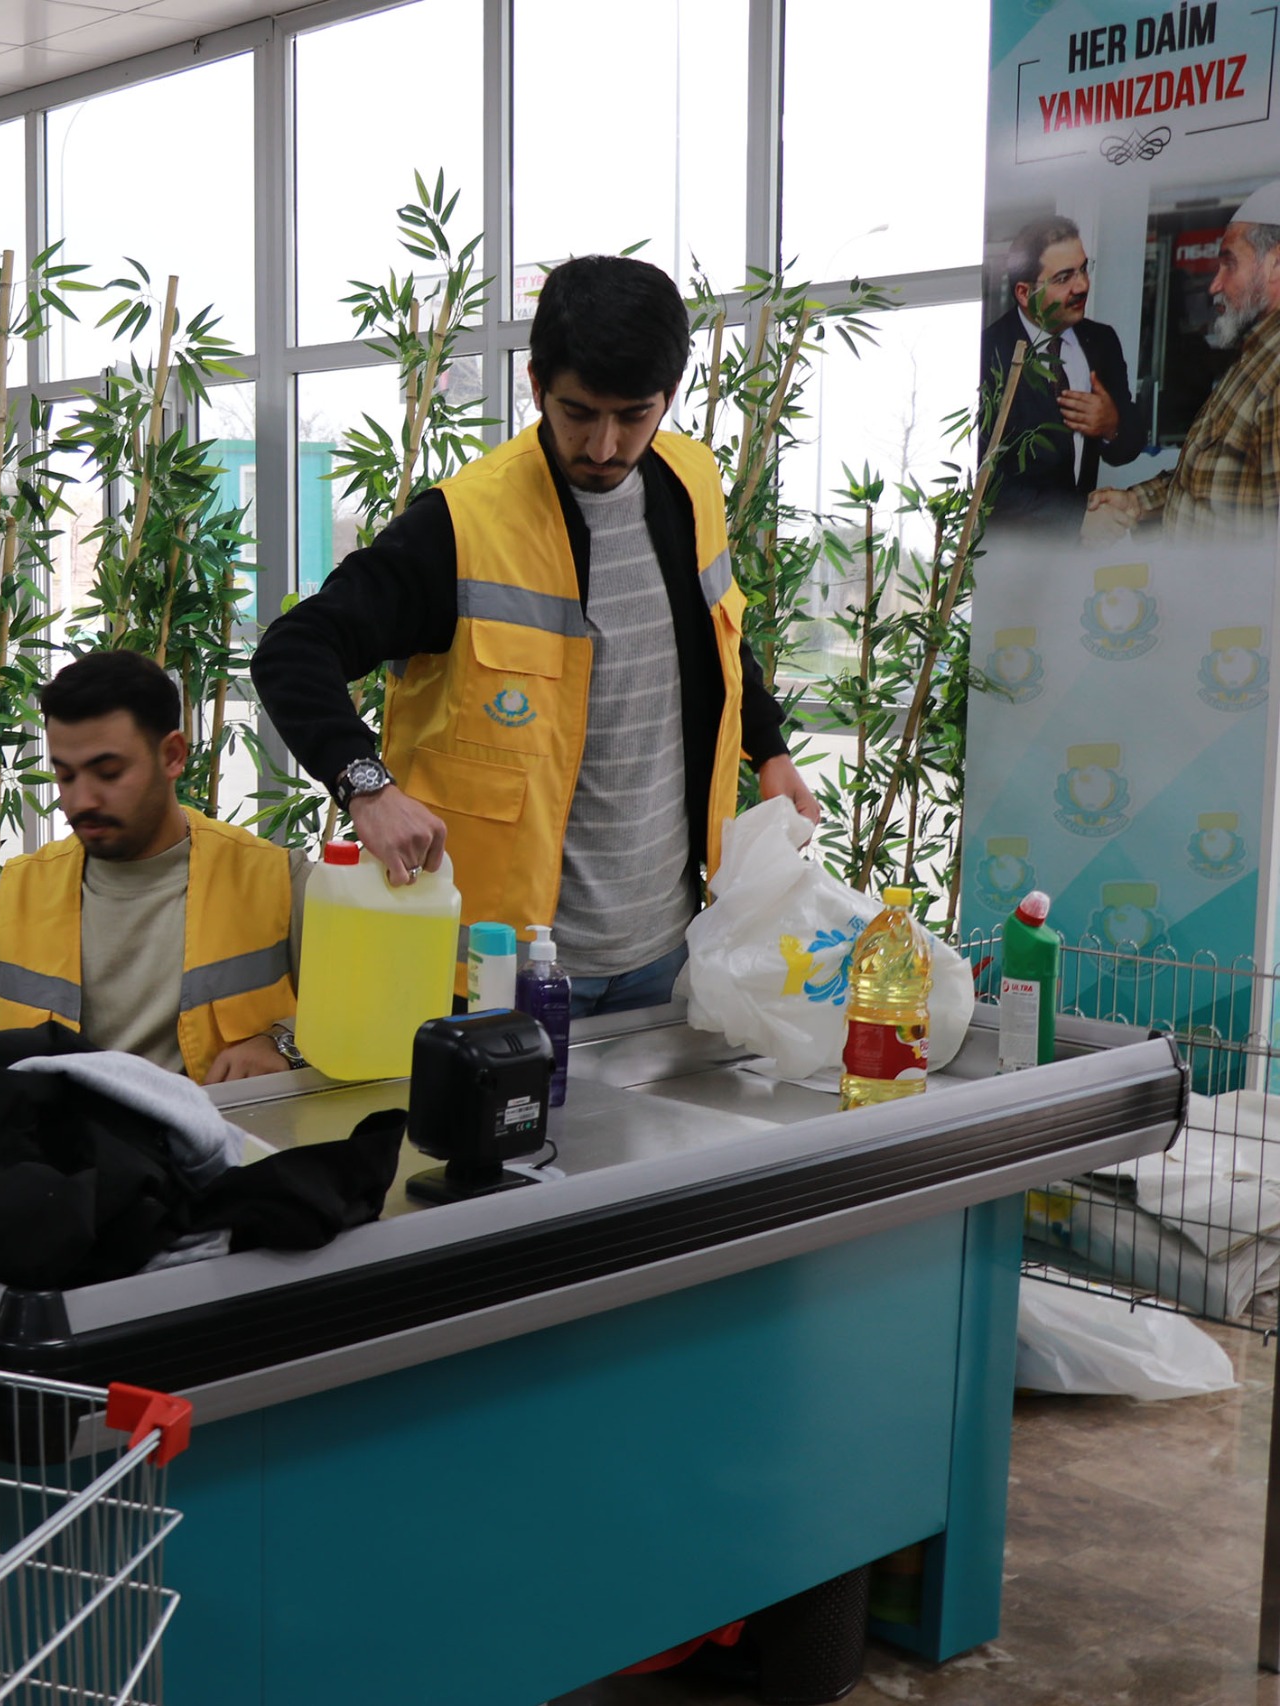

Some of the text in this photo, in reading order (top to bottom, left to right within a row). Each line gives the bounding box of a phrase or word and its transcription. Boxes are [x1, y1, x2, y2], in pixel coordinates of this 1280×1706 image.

[1068, 2, 1218, 74] HER DAİM
[1038, 53, 1248, 134] YANINIZDAYIZ
[1011, 983, 1034, 993] ULTRA
